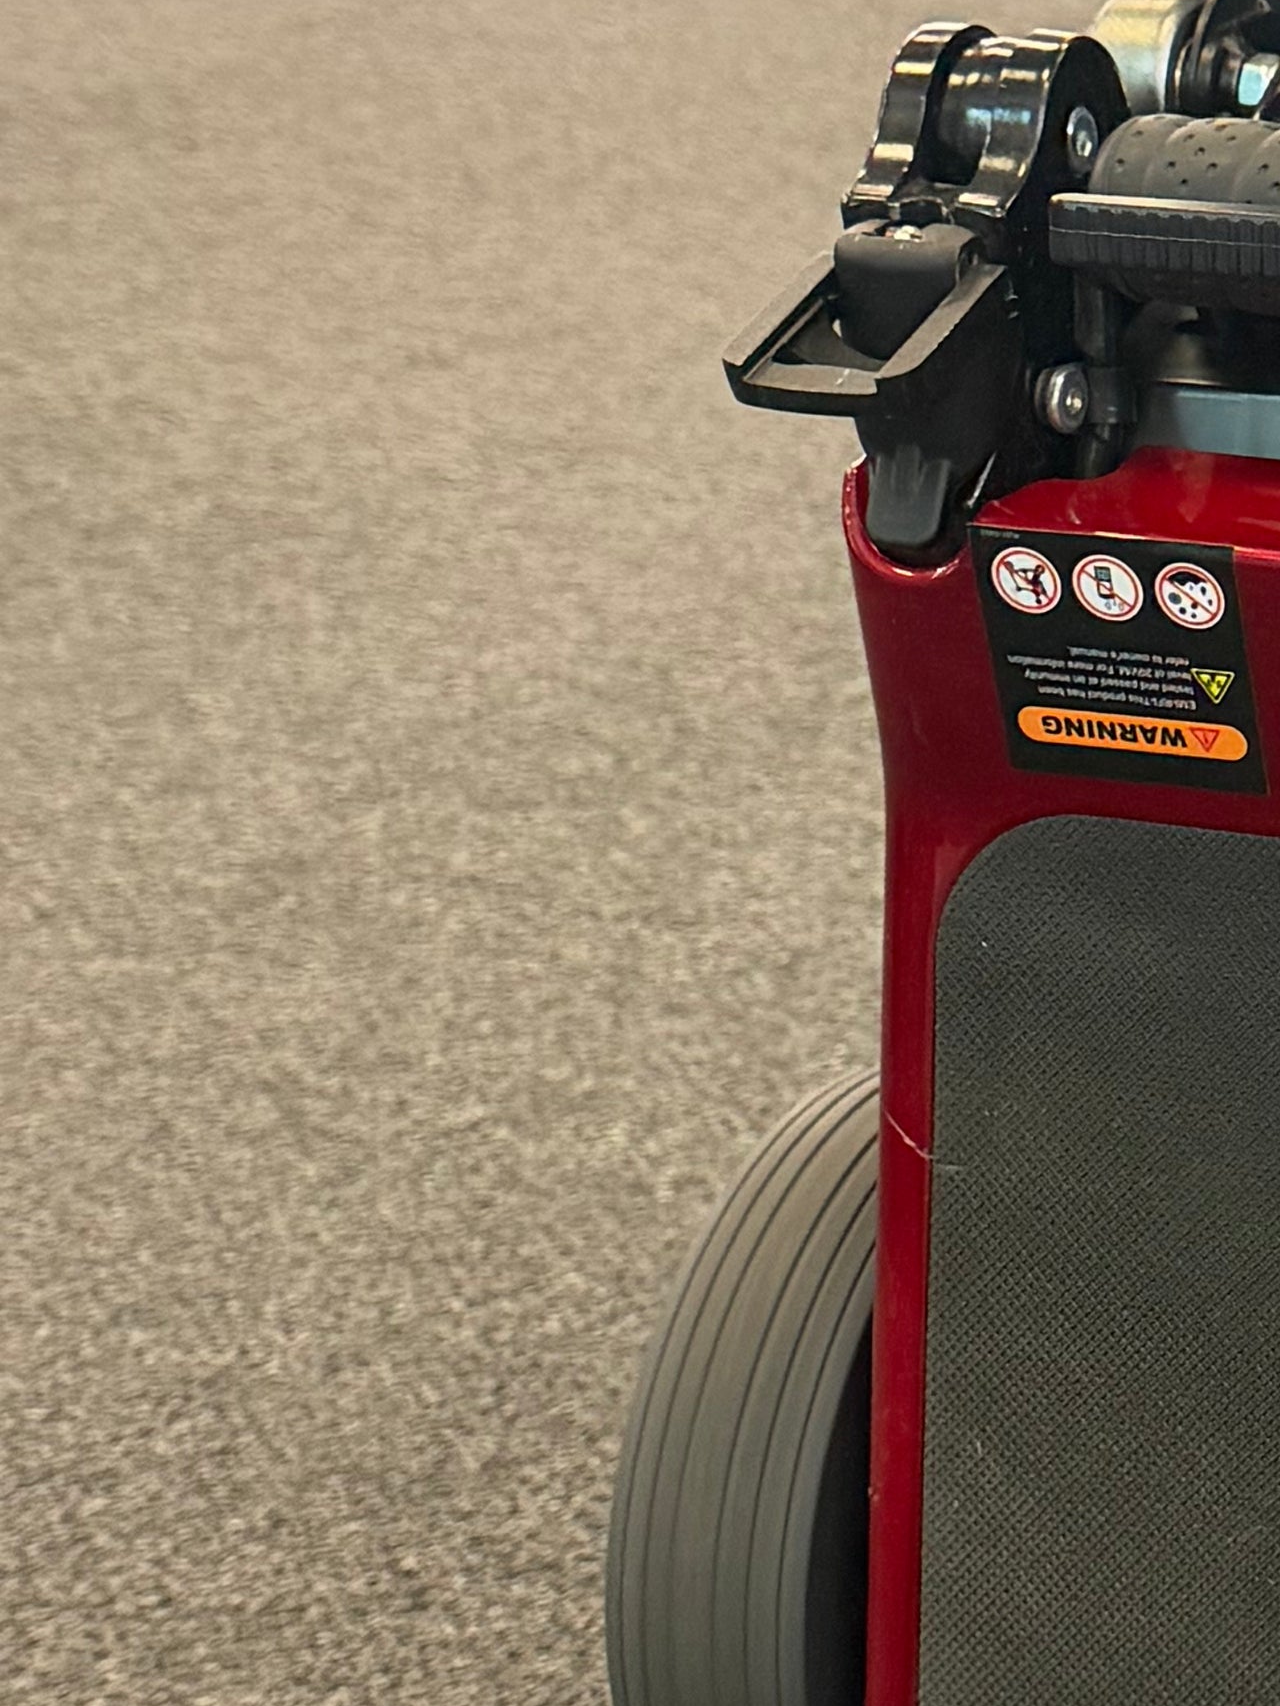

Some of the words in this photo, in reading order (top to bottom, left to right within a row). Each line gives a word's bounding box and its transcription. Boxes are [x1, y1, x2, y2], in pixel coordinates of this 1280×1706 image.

[1095, 663, 1115, 675] For
[1139, 680, 1160, 691] and
[1041, 715, 1188, 748] WARNING
